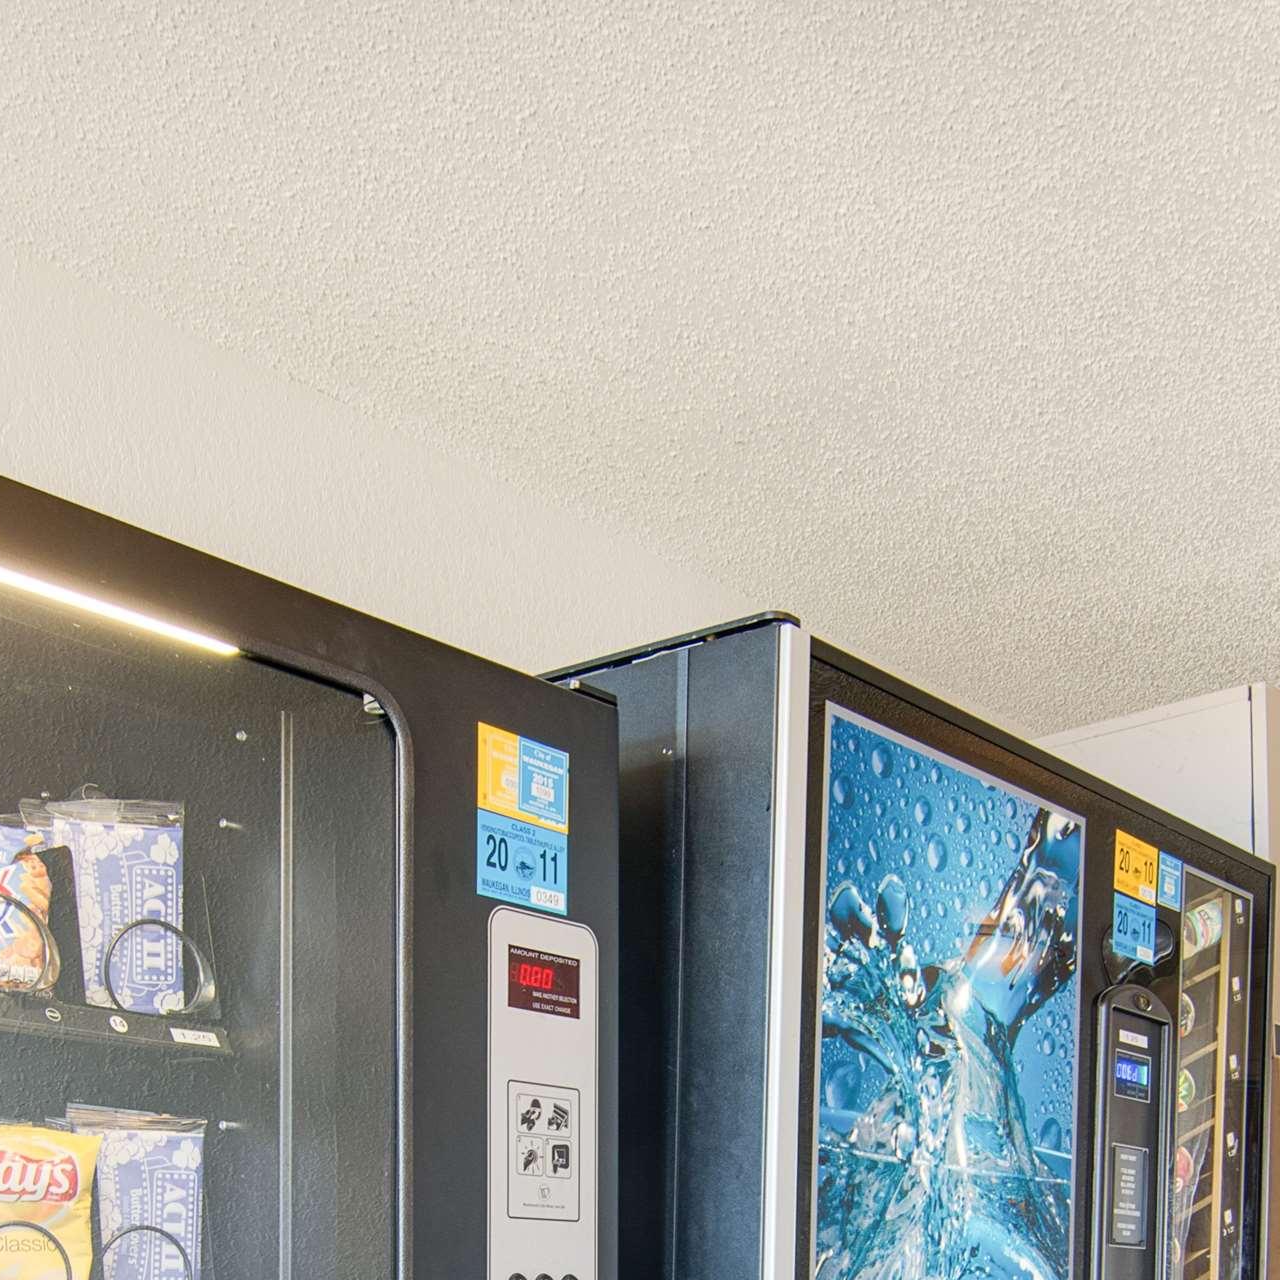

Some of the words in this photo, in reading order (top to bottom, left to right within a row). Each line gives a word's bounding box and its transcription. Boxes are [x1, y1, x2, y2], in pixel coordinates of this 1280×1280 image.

[486, 834, 508, 871] 20
[540, 849, 559, 884] 11
[1119, 848, 1130, 873] 20
[1144, 860, 1153, 884] 10
[142, 878, 166, 937] ACT
[1118, 910, 1128, 935] 20
[1142, 920, 1151, 944] 11
[510, 948, 539, 958] AMOUNT
[540, 953, 577, 966] DEPOSITED
[163, 1184, 187, 1237] ACT
